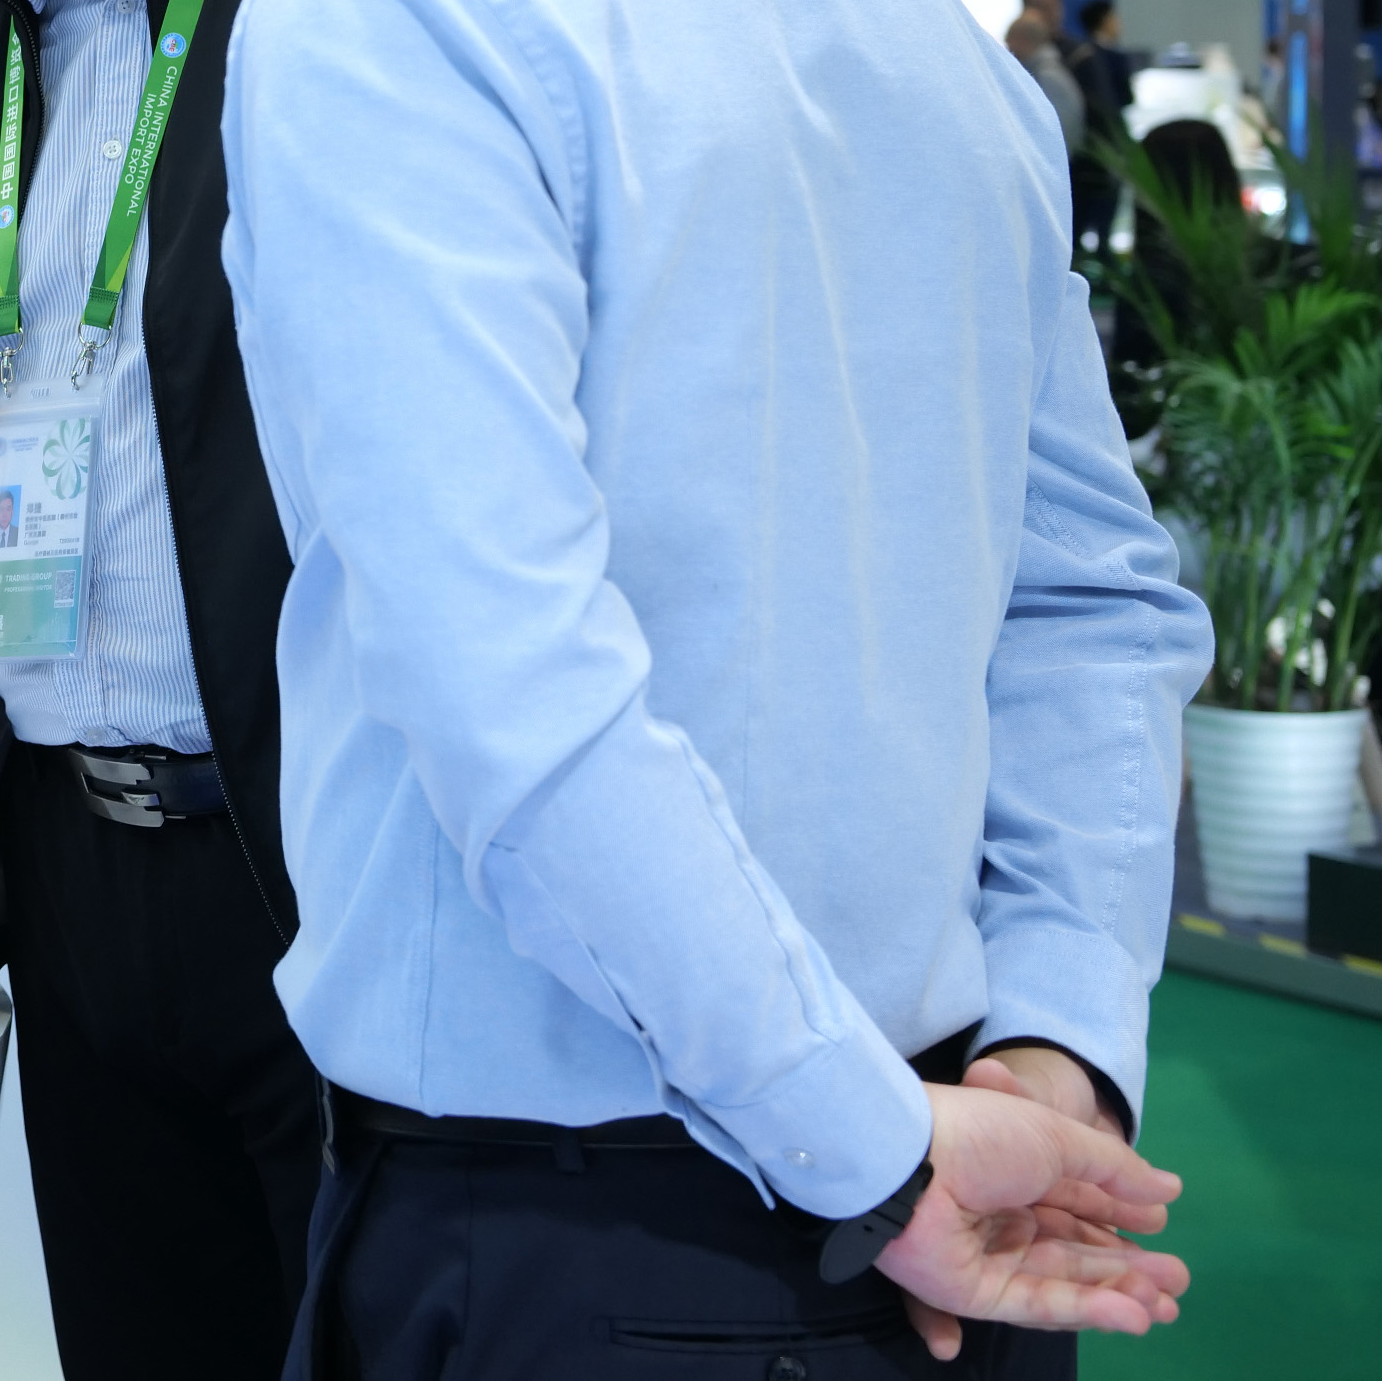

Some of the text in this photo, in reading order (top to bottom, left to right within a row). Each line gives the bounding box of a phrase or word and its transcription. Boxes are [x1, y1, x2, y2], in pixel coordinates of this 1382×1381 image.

[125, 93, 157, 185] IMPORT EXPO
[126, 66, 178, 217] CHINA INTERNATIONAL
